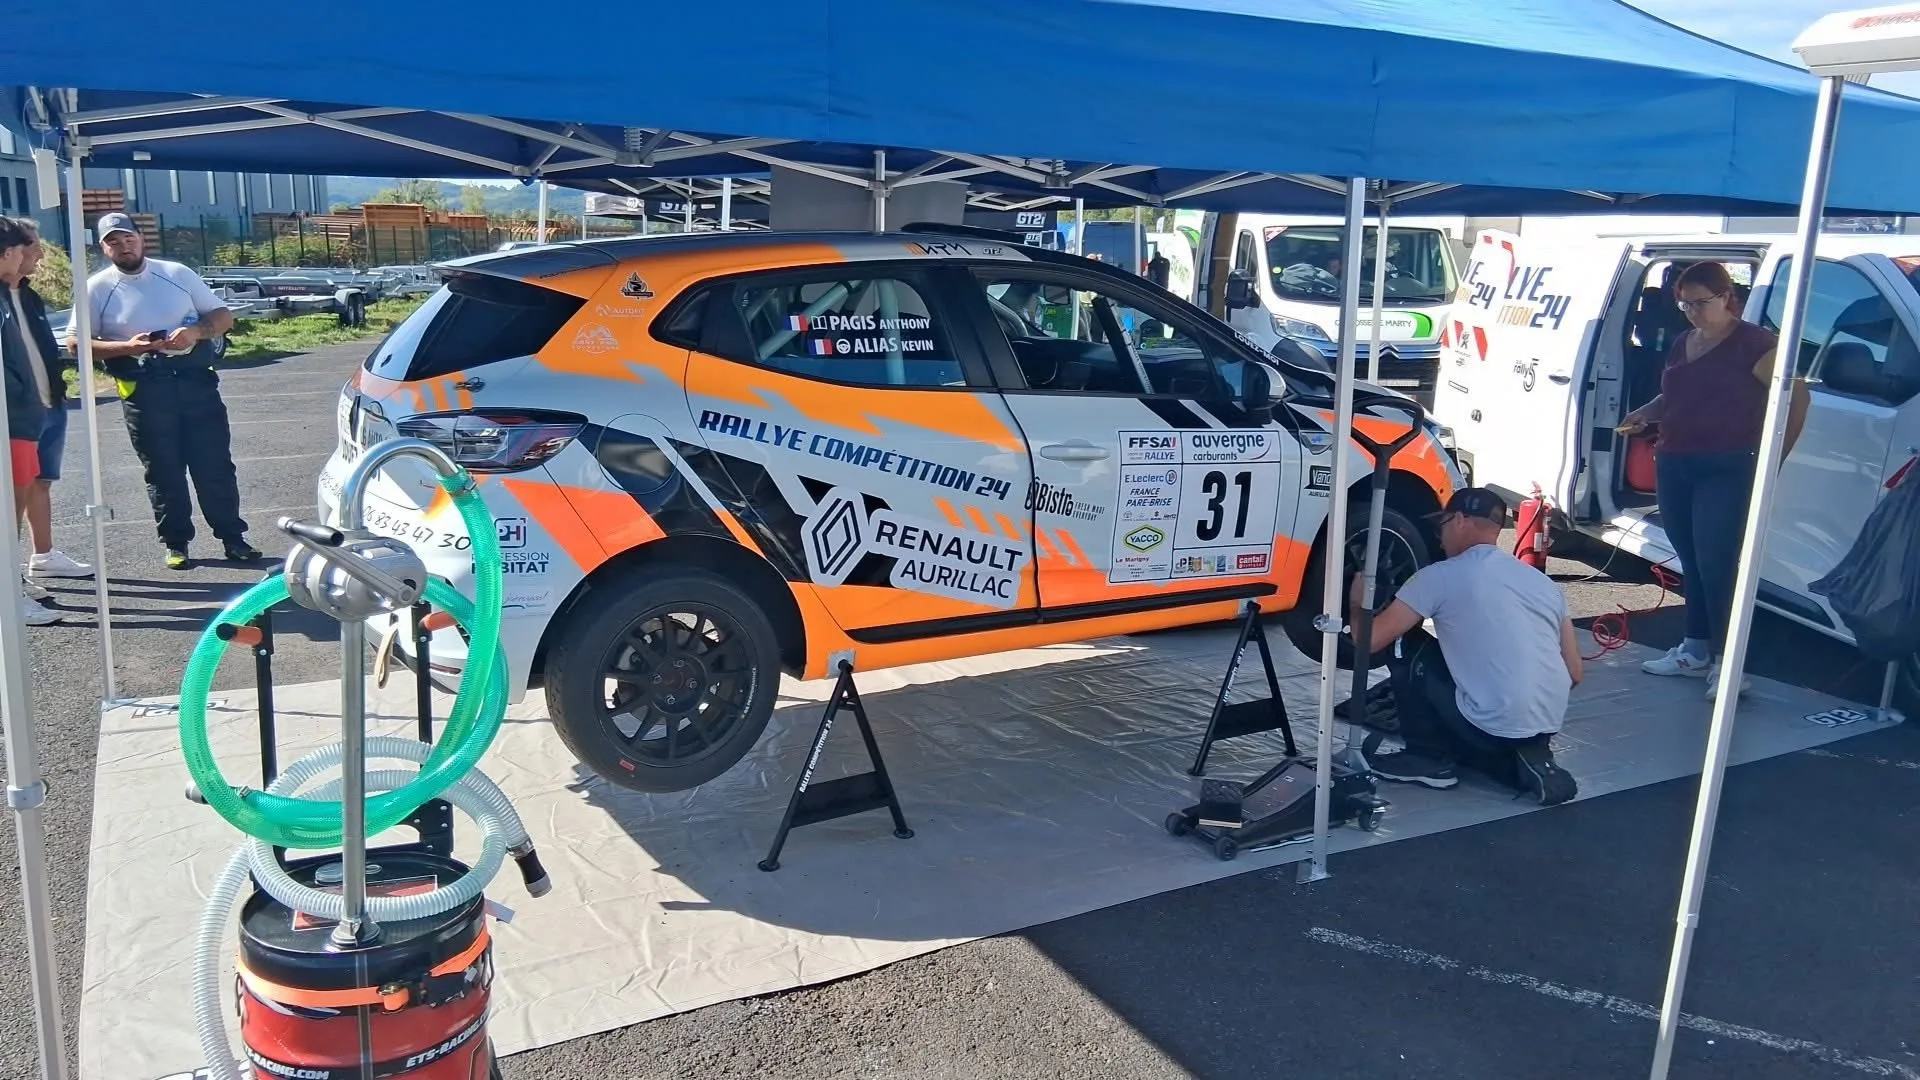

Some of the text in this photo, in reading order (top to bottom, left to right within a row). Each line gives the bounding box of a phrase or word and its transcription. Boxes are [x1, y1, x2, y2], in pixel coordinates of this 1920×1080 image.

[1469, 282, 1497, 310] 24
[1529, 294, 1572, 330] 24
[830, 315, 930, 331] PAGIS ANTHONY
[1385, 320, 1412, 328] MARTY
[854, 337, 934, 353] ALIAS KEVIN
[1234, 331, 1280, 366] LOUEZ-MOI
[1128, 436, 1172, 448] FFSA
[1192, 434, 1265, 454] auvergne
[698, 409, 1012, 501] RALLYE COMPÉTITION 24
[1144, 451, 1176, 460] RALLYE
[1193, 451, 1238, 461] carburants
[1124, 474, 1165, 483] E.Leclerc
[1129, 487, 1161, 495] FRANCE
[1125, 497, 1173, 507] PARE-BRISE
[1196, 470, 1252, 541] 31
[375, 512, 392, 529] 83
[392, 519, 410, 536] 43
[412, 526, 434, 543] 47
[438, 533, 472, 551] 30
[1130, 534, 1159, 543] YACCO
[875, 519, 1023, 572] RENAULT
[900, 559, 1013, 599] AURILLAC
[799, 769, 813, 793] RALLYE
[825, 719, 833, 729] 24
